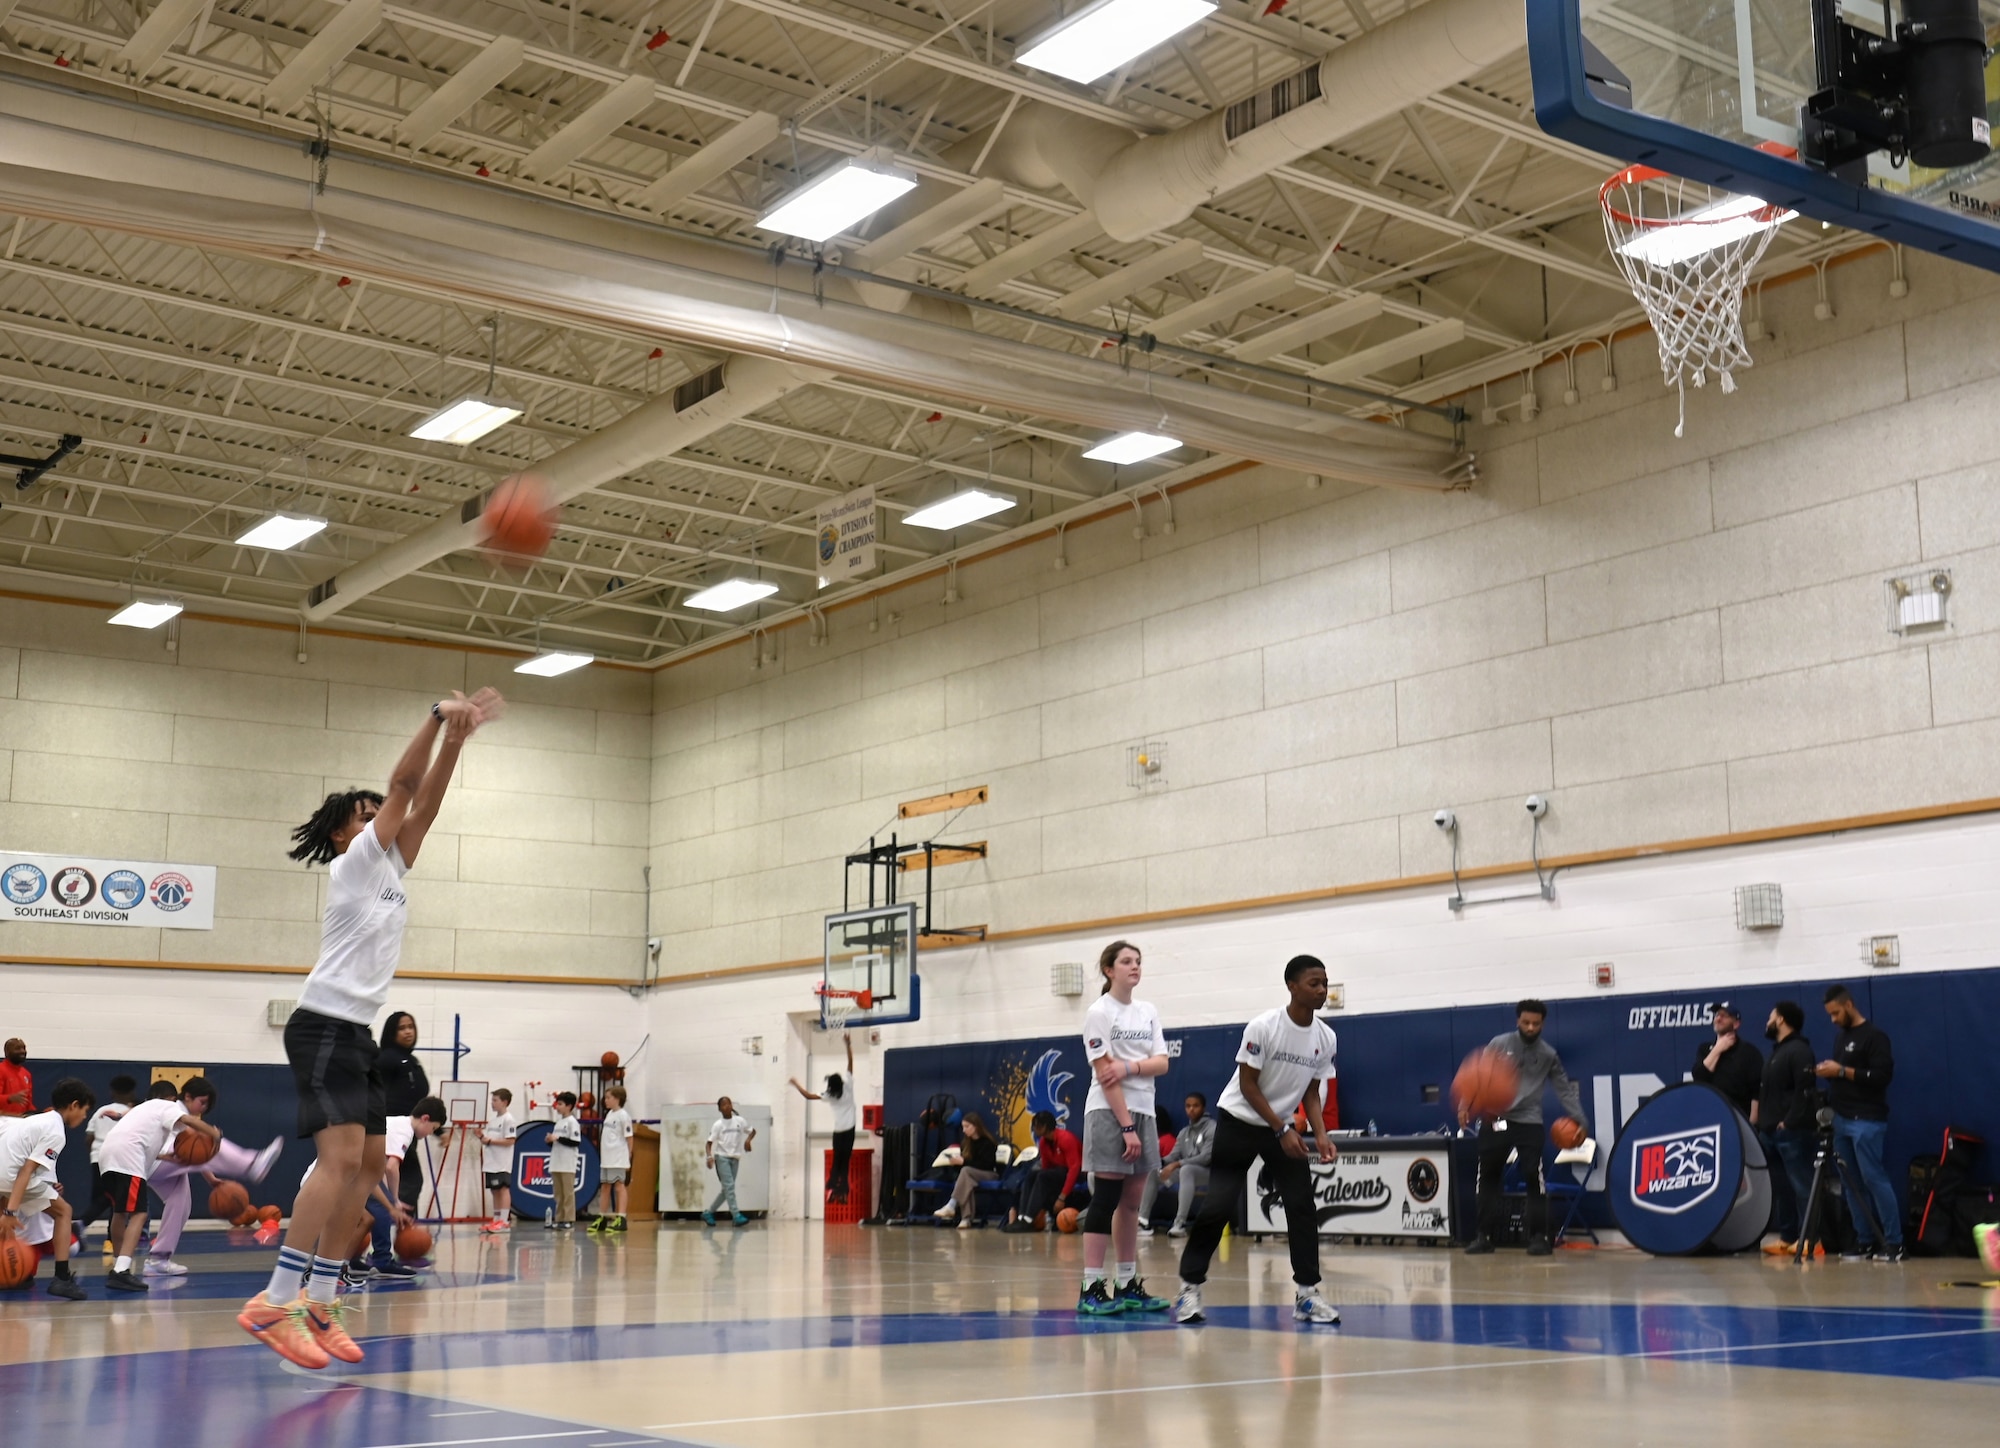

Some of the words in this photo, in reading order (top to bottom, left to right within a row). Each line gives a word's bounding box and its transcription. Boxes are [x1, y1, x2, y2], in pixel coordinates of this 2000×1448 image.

[841, 514, 869, 536] DIVISION
[839, 530, 875, 555] CHAMPIONS
[7, 864, 42, 876] CHARLOTTE
[64, 868, 87, 877] MIAMI
[156, 873, 189, 886] WASHINGTON
[14, 907, 80, 919] SOUTHEAST
[83, 910, 129, 921] DIVISION
[1628, 1002, 1714, 1030] OFFICIALS
[1342, 1154, 1357, 1165] THE
[1310, 1166, 1385, 1204] Falcons
[1402, 1212, 1434, 1229] MWR
